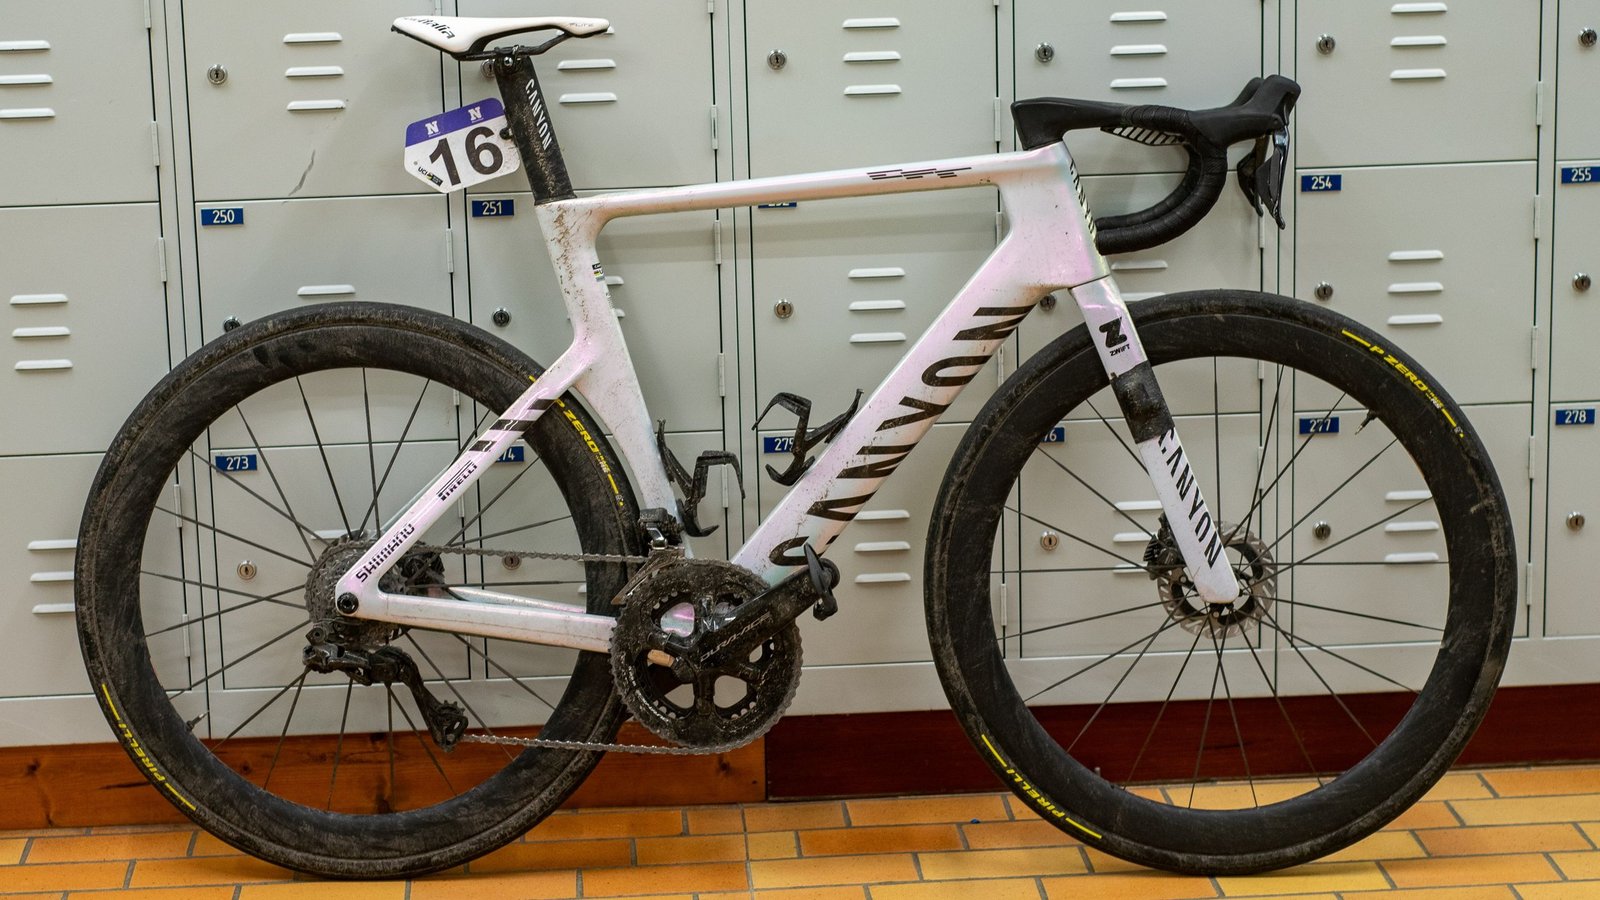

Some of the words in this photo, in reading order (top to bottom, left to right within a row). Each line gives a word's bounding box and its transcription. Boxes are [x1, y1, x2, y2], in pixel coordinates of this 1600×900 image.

[525, 78, 553, 151] CANYON
[417, 166, 429, 176] UCI
[429, 126, 504, 187] 16
[1571, 168, 1592, 182] 255
[1311, 176, 1333, 190] 254
[212, 209, 235, 224] 250
[482, 201, 502, 215] 251
[1109, 343, 1130, 357] ZWIFT
[1384, 354, 1428, 391] ZERO
[563, 409, 600, 453] ZERO
[768, 303, 1038, 566] CANYON
[1309, 419, 1331, 433] 277
[1565, 409, 1587, 424] 278
[226, 456, 249, 470] 273
[436, 460, 478, 501] PIRELLI
[1158, 427, 1225, 569] CANYON
[355, 522, 415, 583] SHIMANO
[118, 723, 165, 782] PIRELLI
[1006, 768, 1065, 818] PIRELLI
